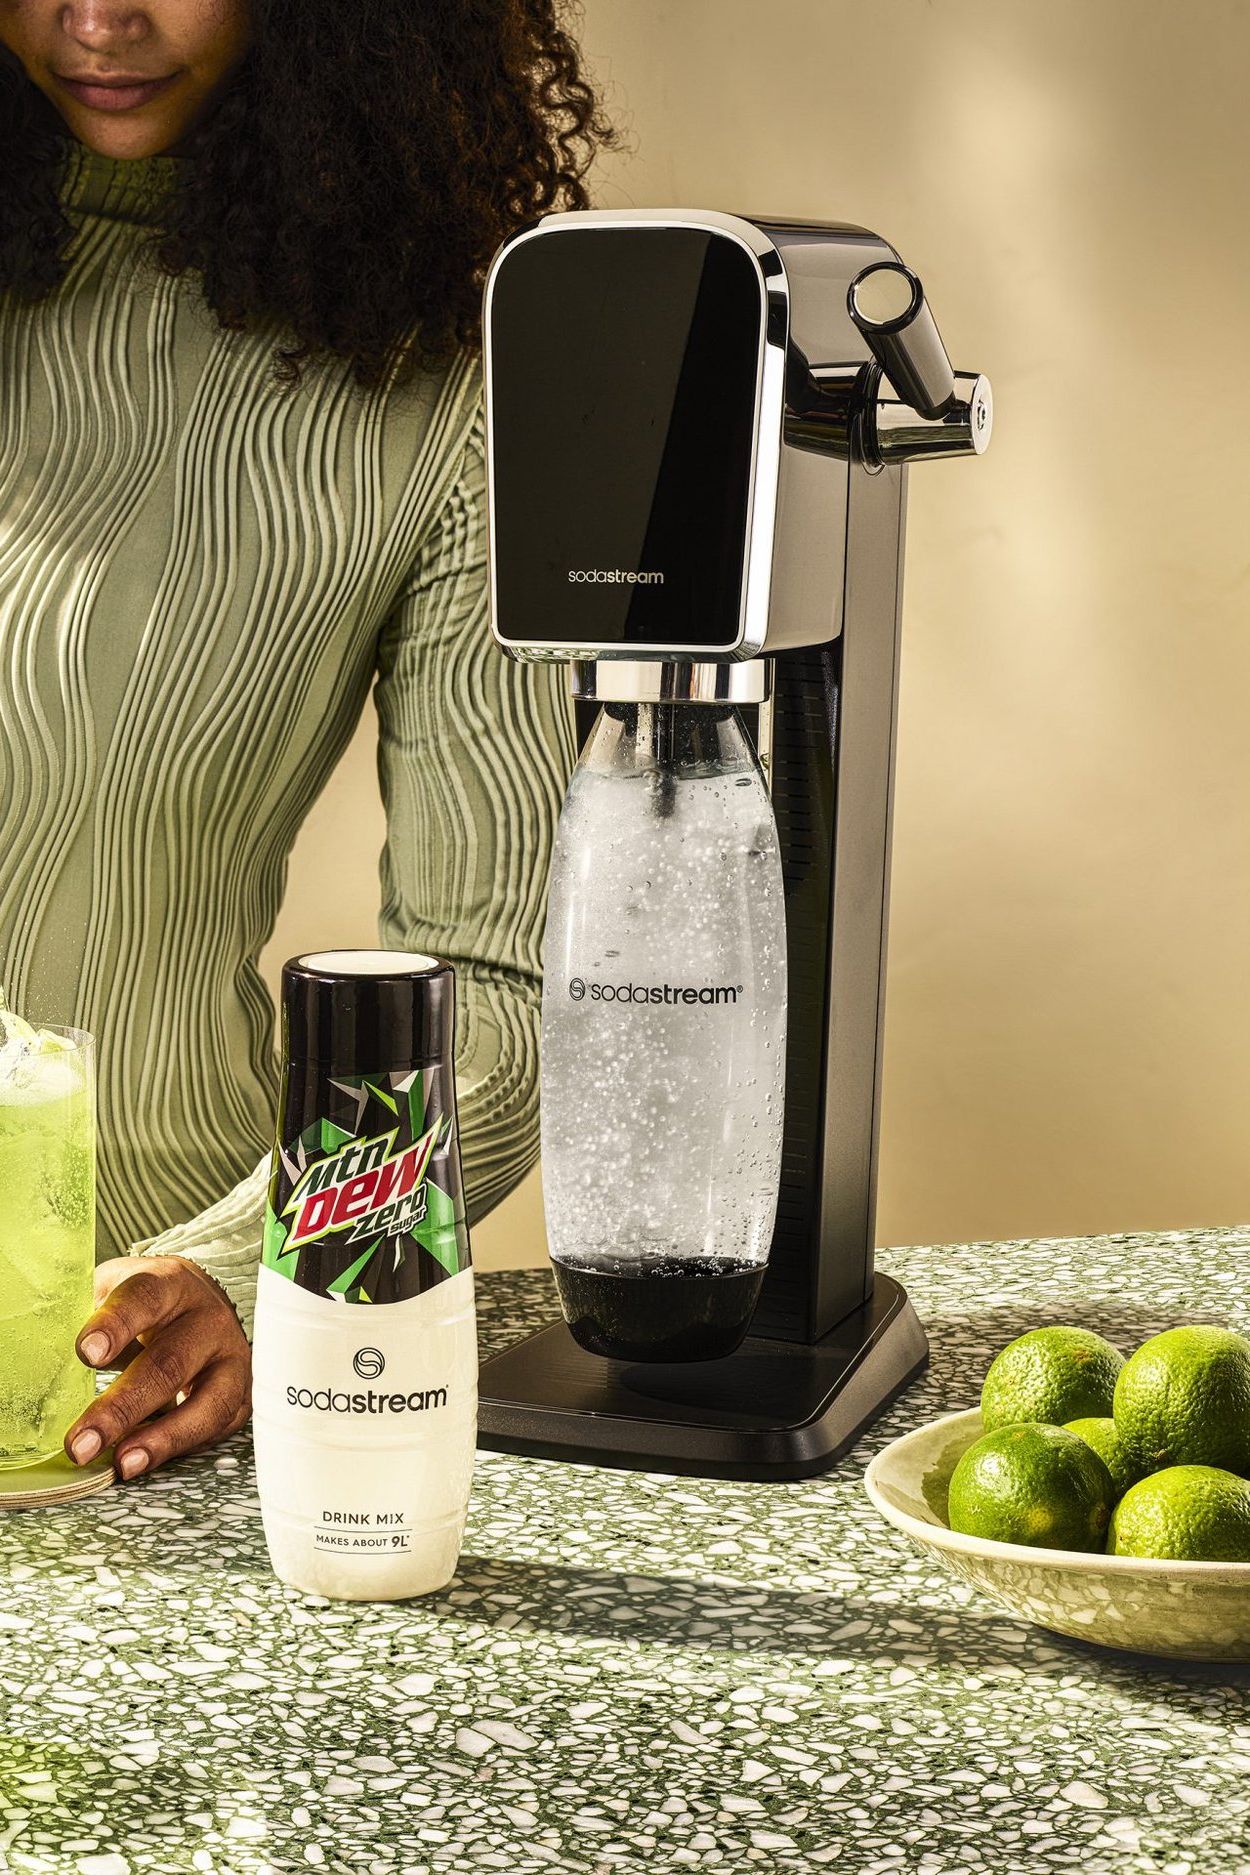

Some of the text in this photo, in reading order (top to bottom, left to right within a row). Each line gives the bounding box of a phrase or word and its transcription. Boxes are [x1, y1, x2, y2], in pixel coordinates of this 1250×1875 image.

[568, 568, 664, 584] sodastream
[346, 1187, 426, 1245] zero
[390, 1207, 425, 1233] sugar
[286, 1385, 447, 1414] sodastream
[322, 1511, 404, 1525] DRINK MIX
[316, 1534, 349, 1546] MAKES
[352, 1538, 387, 1547] ABOUT
